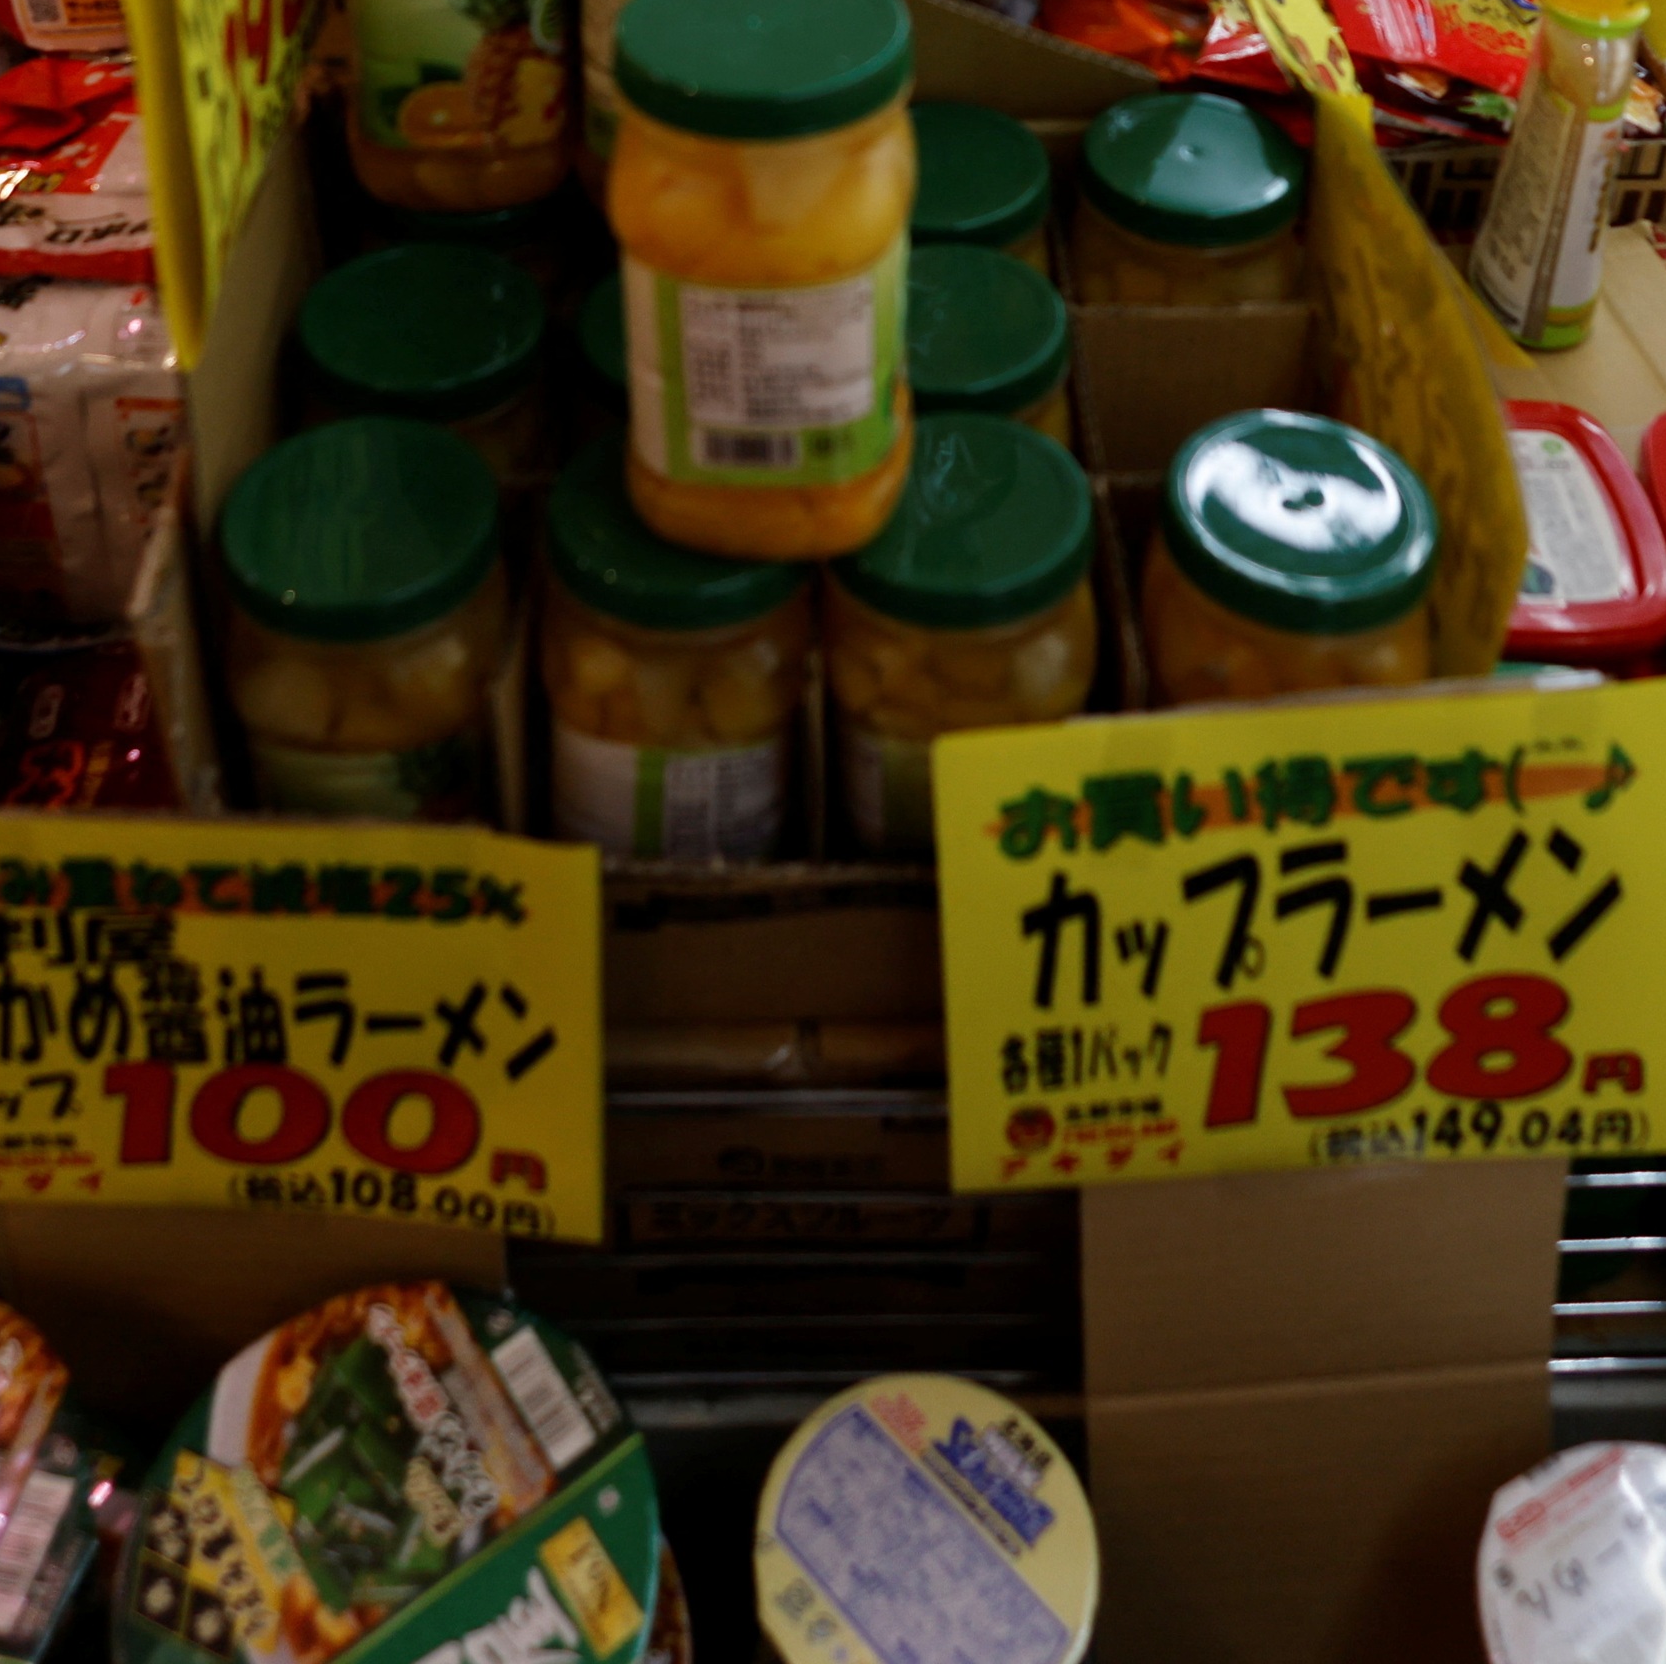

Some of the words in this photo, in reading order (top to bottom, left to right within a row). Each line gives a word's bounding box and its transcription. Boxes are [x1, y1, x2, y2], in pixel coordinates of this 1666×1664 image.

[1023, 830, 1621, 1007] カップラーメン
[104, 1061, 479, 1174] 100
[490, 1152, 546, 1189] 円
[1002, 1026, 1173, 1095] 各種1パック
[1198, 975, 1573, 1130] 138
[1585, 1054, 1644, 1095] 円
